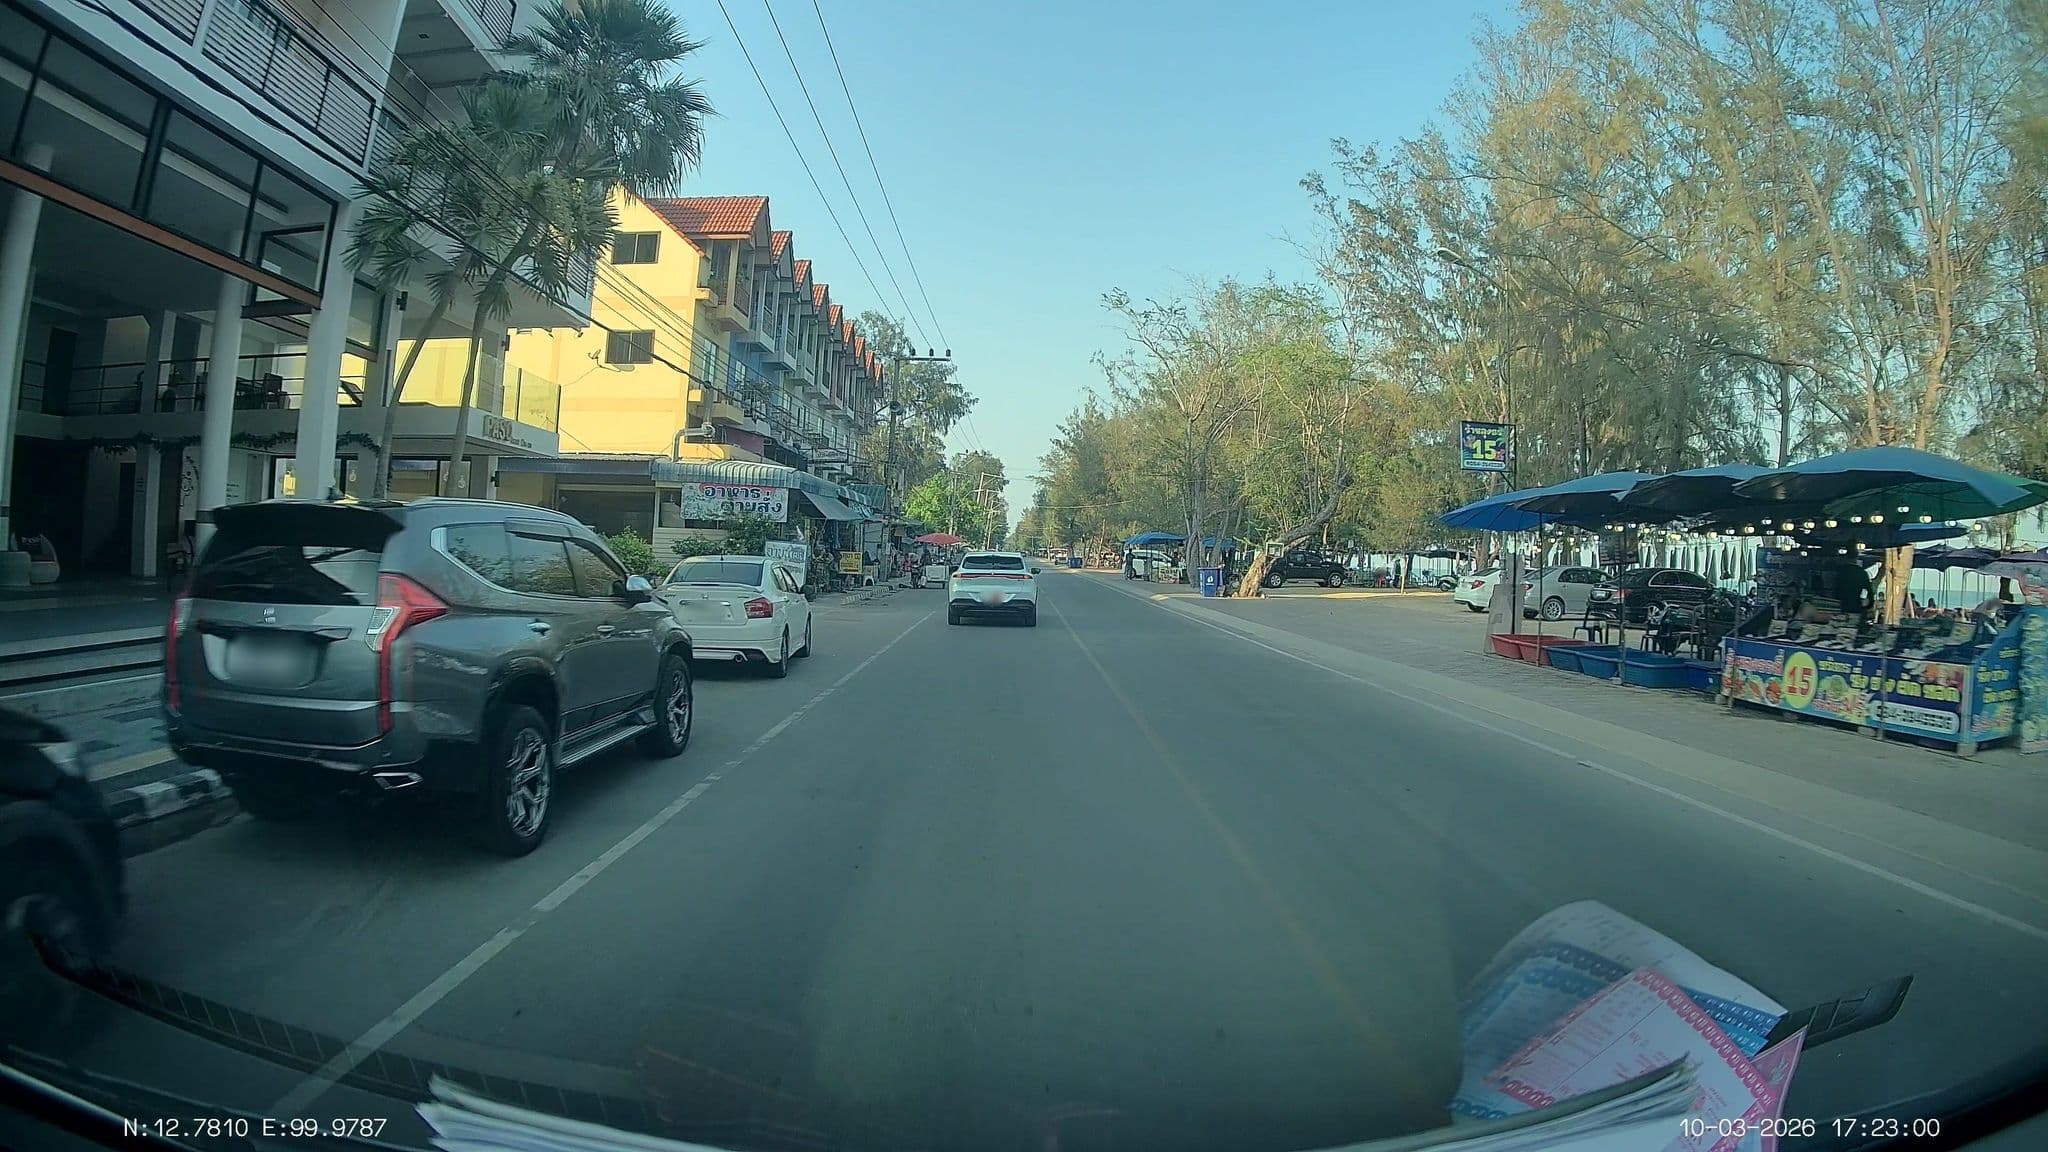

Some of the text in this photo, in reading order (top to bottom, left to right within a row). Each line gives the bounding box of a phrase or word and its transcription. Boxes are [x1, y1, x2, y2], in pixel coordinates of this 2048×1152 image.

[1472, 440, 1497, 459] 15
[704, 486, 761, 499] อาหาร
[720, 491, 782, 513] ตามสั่ง
[1787, 666, 1814, 696] 15
